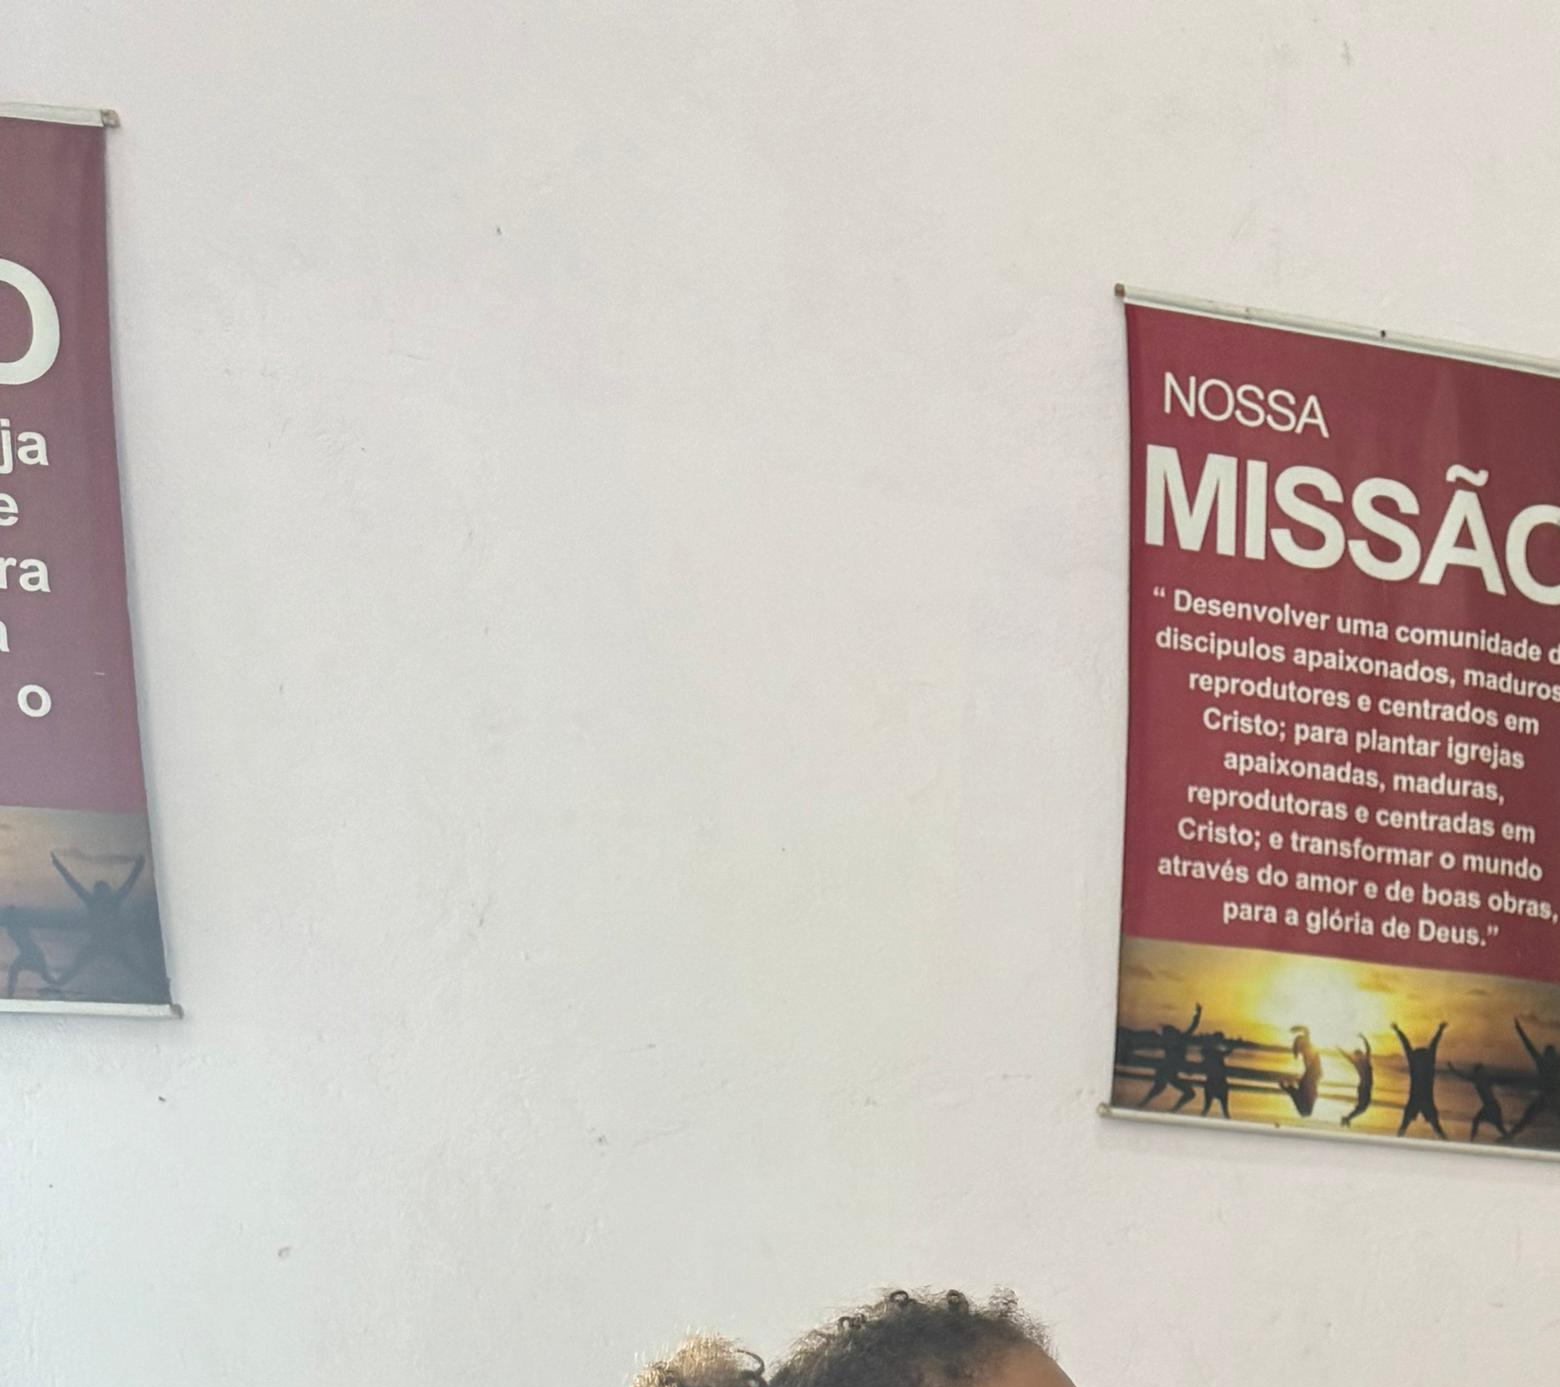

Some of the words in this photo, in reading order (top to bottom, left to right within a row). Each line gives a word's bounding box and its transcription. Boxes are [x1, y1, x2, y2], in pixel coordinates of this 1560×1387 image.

[1163, 371, 1330, 439] NOSSA
[1155, 625, 1286, 663] discipulos
[1292, 647, 1456, 689] apaixonados,
[1173, 588, 1331, 631] Desenvolver
[1336, 615, 1389, 641] uma
[1394, 625, 1542, 662] comunidade
[16, 683, 52, 718] o
[1188, 672, 1351, 709] reprodutores
[1356, 694, 1372, 713] e
[1377, 697, 1499, 728] centrados
[1504, 713, 1540, 736] em
[1202, 706, 1286, 742] Cristo;
[1293, 722, 1349, 746] para
[1355, 728, 1442, 758] plantar
[1446, 735, 1525, 770] igrejas
[1223, 751, 1386, 793] apaixonadas,
[1392, 771, 1505, 805] maduras,
[1187, 785, 1349, 821] reprodutoras
[1354, 805, 1370, 824] e
[1375, 808, 1495, 837] centradas
[1501, 822, 1536, 844] em
[1177, 816, 1261, 852] Cristo;
[1268, 831, 1284, 850] e
[1290, 830, 1434, 868] transformar
[1439, 851, 1456, 870] o
[1462, 853, 1543, 881] mundo
[1157, 854, 1250, 884] através
[1256, 863, 1289, 888] do
[1295, 872, 1359, 896] amor
[1363, 881, 1379, 900] e
[1384, 879, 1415, 904] de
[1421, 882, 1482, 909] boas
[1487, 890, 1559, 923] obras,
[1222, 901, 1278, 925] para
[1284, 907, 1299, 927] a
[1305, 906, 1375, 936] glória
[1380, 915, 1411, 940] de
[1417, 918, 1499, 947] Deus.”
